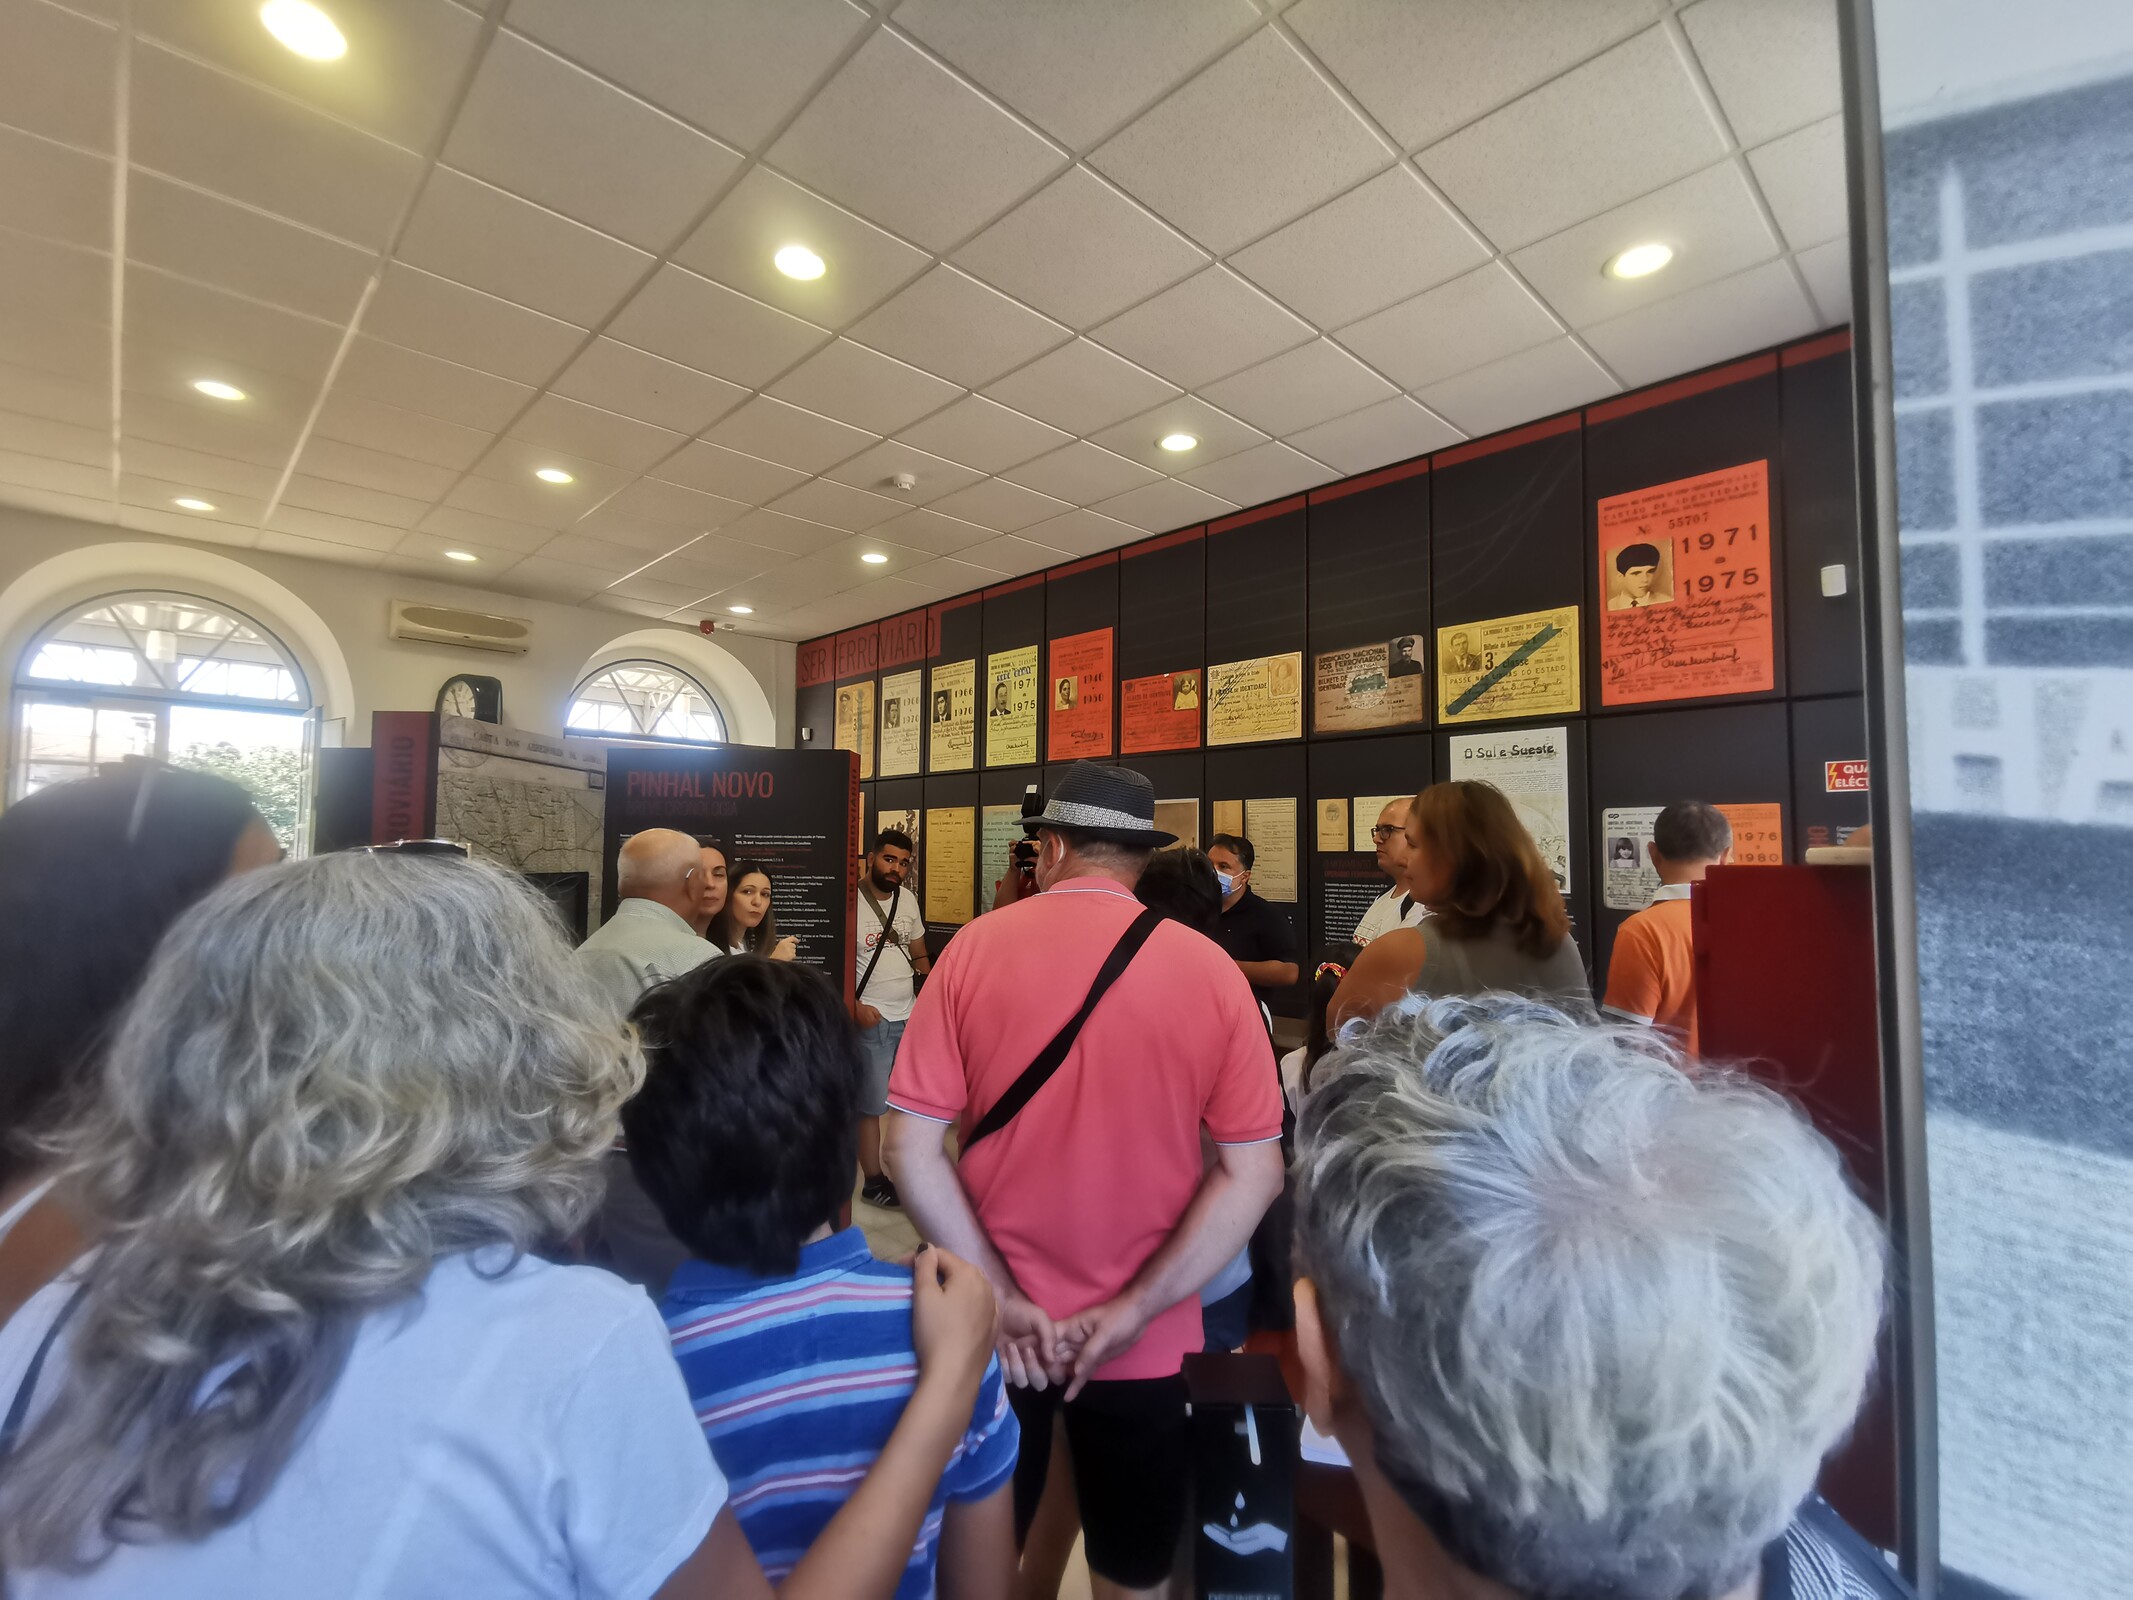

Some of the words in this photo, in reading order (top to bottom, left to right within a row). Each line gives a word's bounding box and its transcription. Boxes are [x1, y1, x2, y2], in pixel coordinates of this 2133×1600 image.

[1668, 511, 1710, 530] 55707
[1681, 523, 1758, 555] 1971
[1682, 567, 1761, 598] 1975
[801, 648, 827, 683] SER
[832, 617, 936, 675] FERROVIÁRIO
[1352, 647, 1387, 658] NACIONAL
[1318, 662, 1332, 671] DOS
[1318, 676, 1339, 685] BILHETE
[1450, 676, 1472, 684] PASSE
[1535, 665, 1566, 674] ESTADO
[1013, 677, 1036, 690] 1971
[1240, 682, 1267, 692] IDENTIDADE
[1318, 682, 1346, 692] IDENTIDADE
[954, 687, 973, 698] 1966
[1013, 699, 1036, 712] 1975
[954, 707, 973, 717] 1970
[1464, 748, 1473, 759] O
[1476, 745, 1497, 758] Sul
[1500, 749, 1507, 757] e
[1511, 744, 1554, 756] Sueste
[627, 771, 705, 797] PINHAL
[712, 771, 775, 798] NOVO
[1737, 831, 1778, 842] 1976
[1738, 854, 1779, 863] 1980
